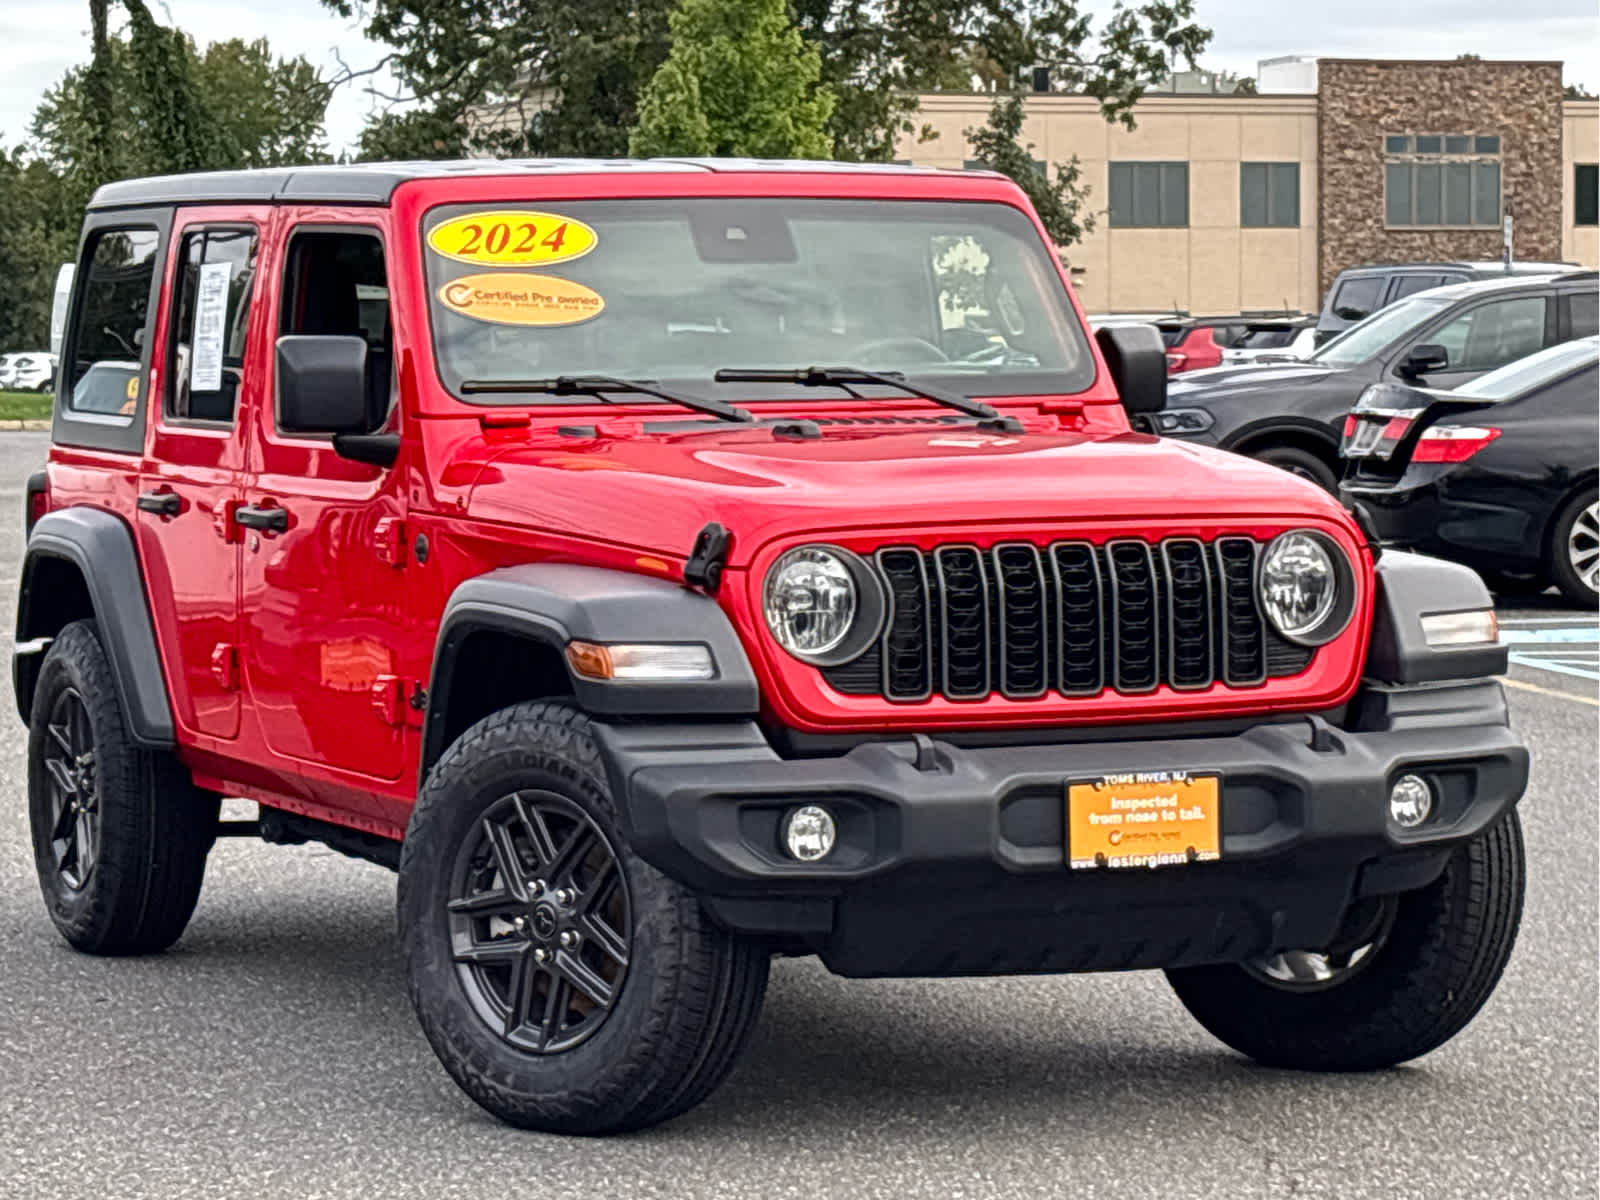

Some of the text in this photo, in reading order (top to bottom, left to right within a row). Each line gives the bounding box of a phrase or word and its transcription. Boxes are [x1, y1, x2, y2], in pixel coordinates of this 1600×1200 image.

[457, 223, 568, 254] 2024
[474, 290, 528, 302] Certified
[1104, 773, 1133, 784] TOMS
[1112, 794, 1177, 811] Inspected
[1088, 812, 1122, 825] from
[1125, 811, 1158, 823] nose
[1161, 809, 1177, 822] to
